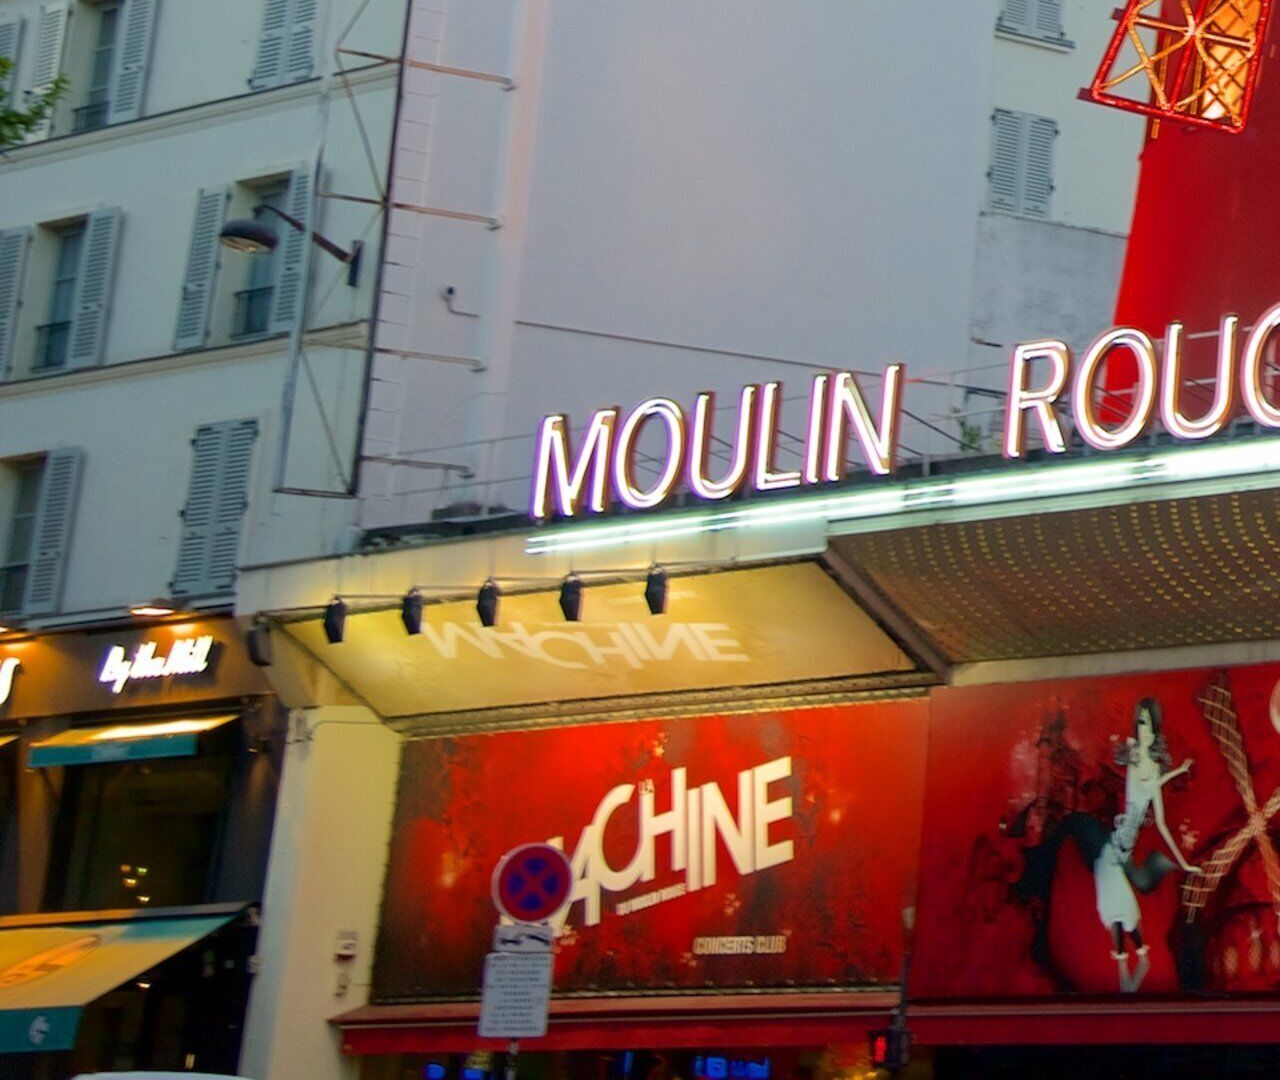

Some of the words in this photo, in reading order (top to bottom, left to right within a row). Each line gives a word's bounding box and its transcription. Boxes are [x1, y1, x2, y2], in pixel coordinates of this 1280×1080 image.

[531, 361, 904, 520] MOULIN
[693, 936, 754, 955] CONCERTS
[754, 935, 787, 954] CLUB
